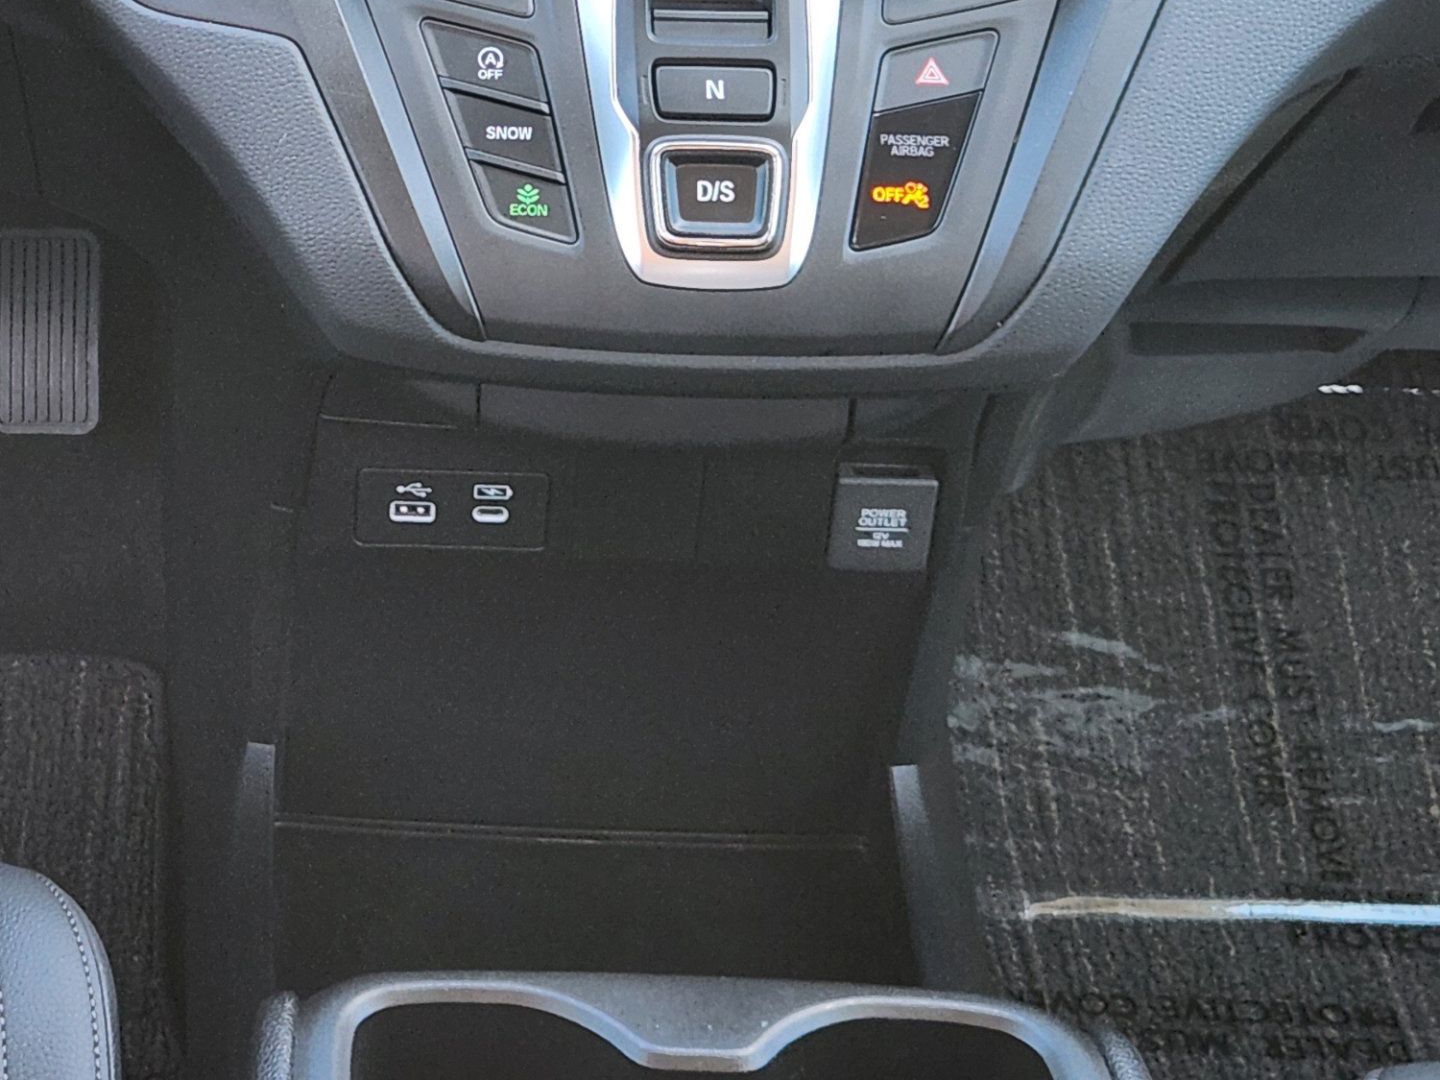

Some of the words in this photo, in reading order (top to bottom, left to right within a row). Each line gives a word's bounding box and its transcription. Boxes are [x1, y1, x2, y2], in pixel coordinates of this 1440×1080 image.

[477, 70, 503, 80] OFF
[706, 80, 725, 99] N
[486, 126, 533, 140] SNOW
[880, 133, 950, 147] PASSENGER
[890, 146, 935, 158] AIRBAG
[696, 180, 735, 203] D/S
[872, 186, 904, 203] OFF
[510, 204, 548, 216] ECON
[861, 508, 907, 518] POWER
[858, 517, 908, 527] OUTLET
